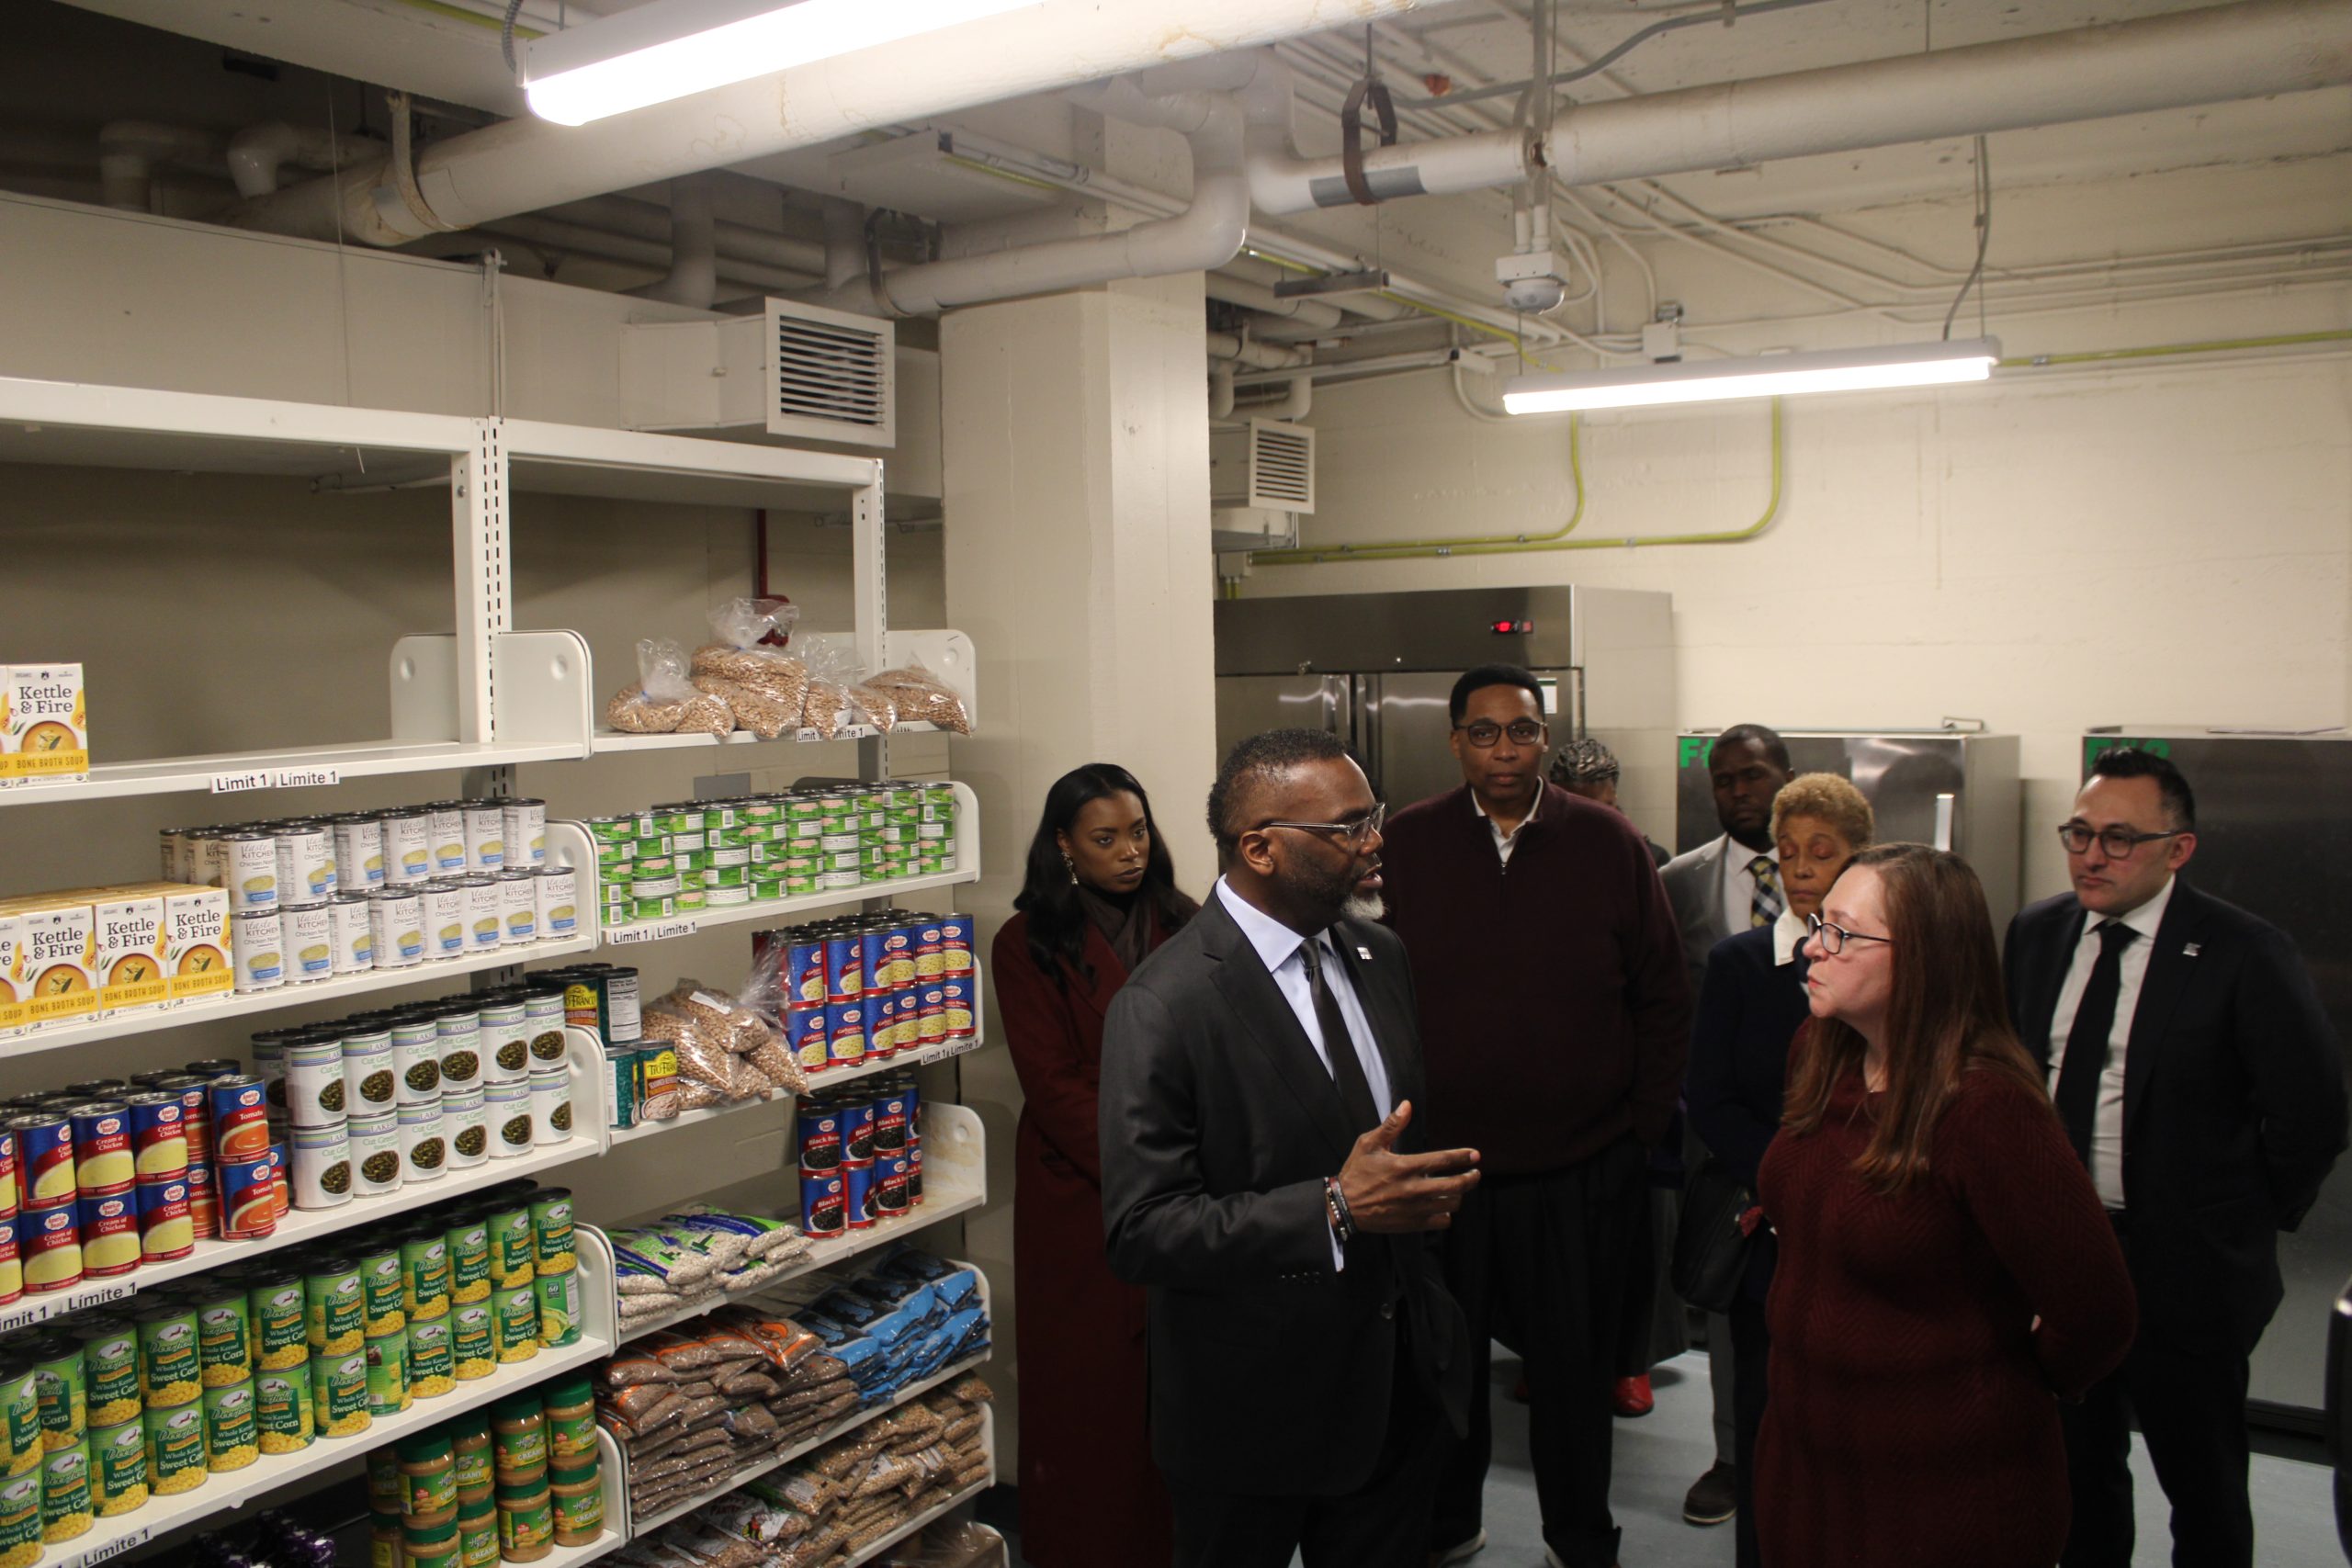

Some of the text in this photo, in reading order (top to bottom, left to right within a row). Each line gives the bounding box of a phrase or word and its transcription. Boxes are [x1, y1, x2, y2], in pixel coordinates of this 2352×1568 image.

[18, 684, 73, 700] Kettle
[20, 701, 74, 715] & Fire
[65, 756, 85, 766] SOUP
[216, 773, 266, 792] Limit 1
[280, 771, 336, 786] Límite 1
[176, 910, 220, 928] Kettle
[107, 919, 154, 936] Kettle
[691, 921, 695, 931] 1
[33, 928, 83, 945] Kettle
[178, 925, 220, 941] & Fire
[614, 929, 648, 943] Limit 1
[108, 933, 155, 949] & Fire
[34, 942, 85, 961] & Fire
[214, 975, 231, 985] SOUP
[148, 984, 165, 995] SOUP
[77, 997, 96, 1009] SOUP
[922, 1052, 940, 1064] Limit
[239, 1110, 263, 1122] Tomato
[158, 1122, 183, 1134] Cream of
[160, 1129, 182, 1138] Chicken
[96, 1137, 117, 1146] Cream
[98, 1142, 123, 1152] Chicken
[164, 1203, 181, 1213] Cream
[165, 1208, 187, 1218] Chicken
[98, 1219, 120, 1228] Cream
[100, 1223, 126, 1234] Chicken
[45, 1229, 72, 1243] Cream of
[47, 1236, 72, 1247] Chicken
[130, 1282, 137, 1294] 1
[0, 1305, 47, 1331] imit 1
[265, 1337, 290, 1347] Sweet
[222, 1349, 244, 1360] Corn
[150, 1365, 198, 1383] Sweet Corn
[90, 1391, 119, 1402] Sweet
[41, 1415, 69, 1426] Corn
[275, 1420, 299, 1431] Corn
[213, 1438, 240, 1449] Sweet
[159, 1459, 187, 1471] Sweet
[107, 1476, 136, 1491] Sweet
[141, 1529, 150, 1540] 1
